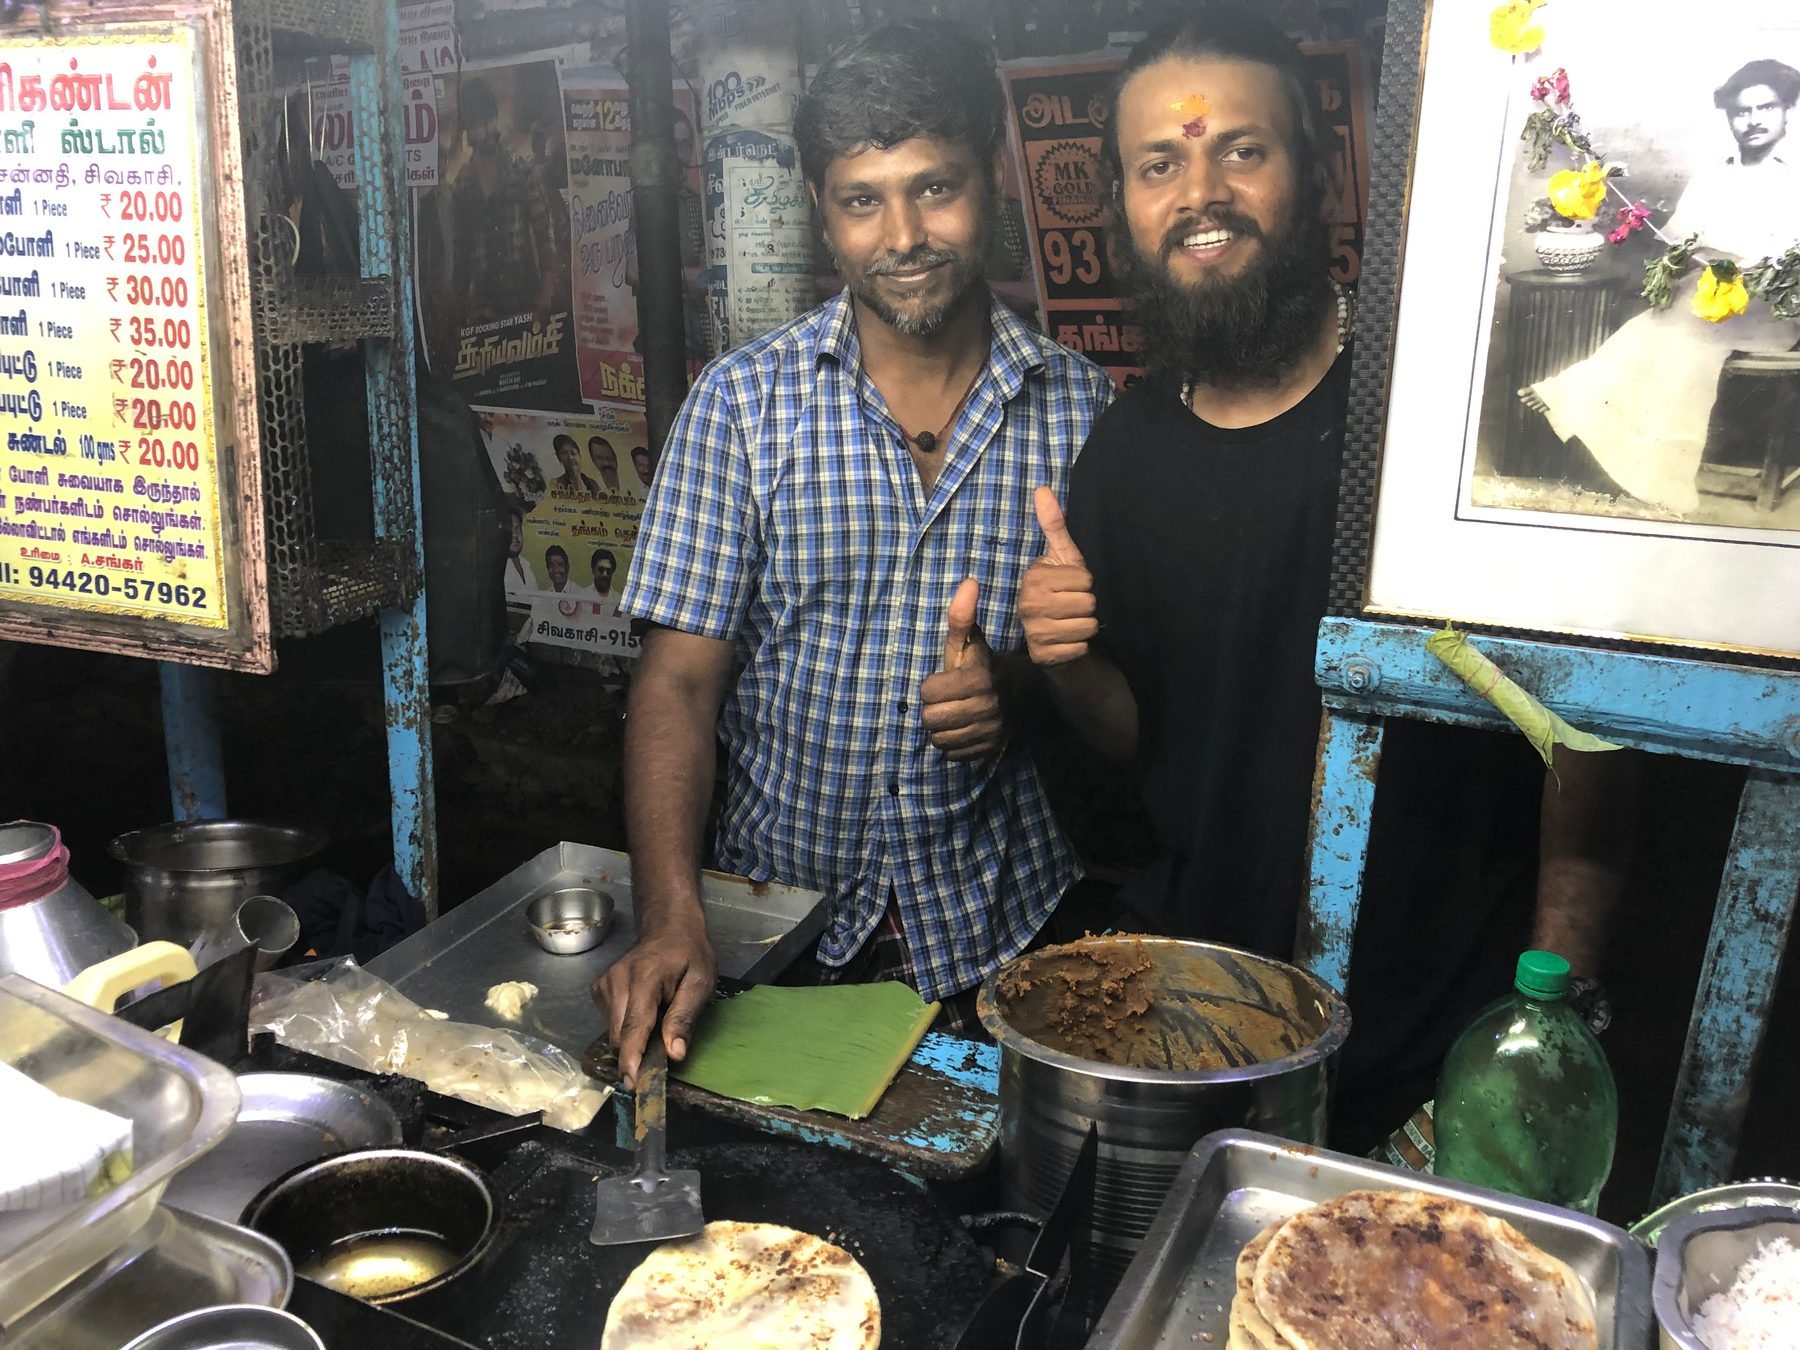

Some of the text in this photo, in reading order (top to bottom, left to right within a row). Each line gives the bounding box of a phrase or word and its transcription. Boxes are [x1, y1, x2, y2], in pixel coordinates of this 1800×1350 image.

[0, 55, 173, 112] ிகண்டன்
[60, 118, 166, 155] ஸ்டால்
[1053, 161, 1090, 181] MK
[1052, 181, 1096, 195] GOLD
[34, 200, 39, 216] 1
[42, 199, 68, 216] Piece
[119, 190, 183, 223] 20.00
[0, 230, 54, 258] போளி
[65, 242, 71, 258] 1
[74, 241, 100, 259] Piece
[122, 233, 186, 266] 25.00
[51, 282, 56, 298] 1
[60, 281, 86, 300] Piece
[126, 275, 188, 308] 30.00
[38, 321, 44, 337] 1
[47, 321, 73, 339] Piece
[129, 316, 191, 350] 35.00
[514, 312, 533, 326] YASH
[0, 350, 38, 383] புட்டு
[48, 361, 53, 377] 1
[56, 361, 82, 379] Piece
[130, 357, 194, 391] 20.00
[53, 401, 59, 417] 1
[61, 401, 87, 420] Piece
[132, 398, 197, 431] 20.00
[8, 426, 68, 456] சுண்டல்
[79, 434, 95, 460] 100
[97, 440, 116, 467] gms
[138, 437, 199, 471] 20.00
[9, 465, 202, 506] போளி சுவையாக இருந்தால்
[15, 492, 104, 520] நண்பர்களிடம்
[0, 516, 66, 543] ல்லாவிட்டால்
[72, 525, 128, 550] எங்களிடம்
[20, 546, 61, 563] உரிமை
[29, 565, 208, 609] 94420-57962
[536, 620, 641, 649] சிவகாசி-915
